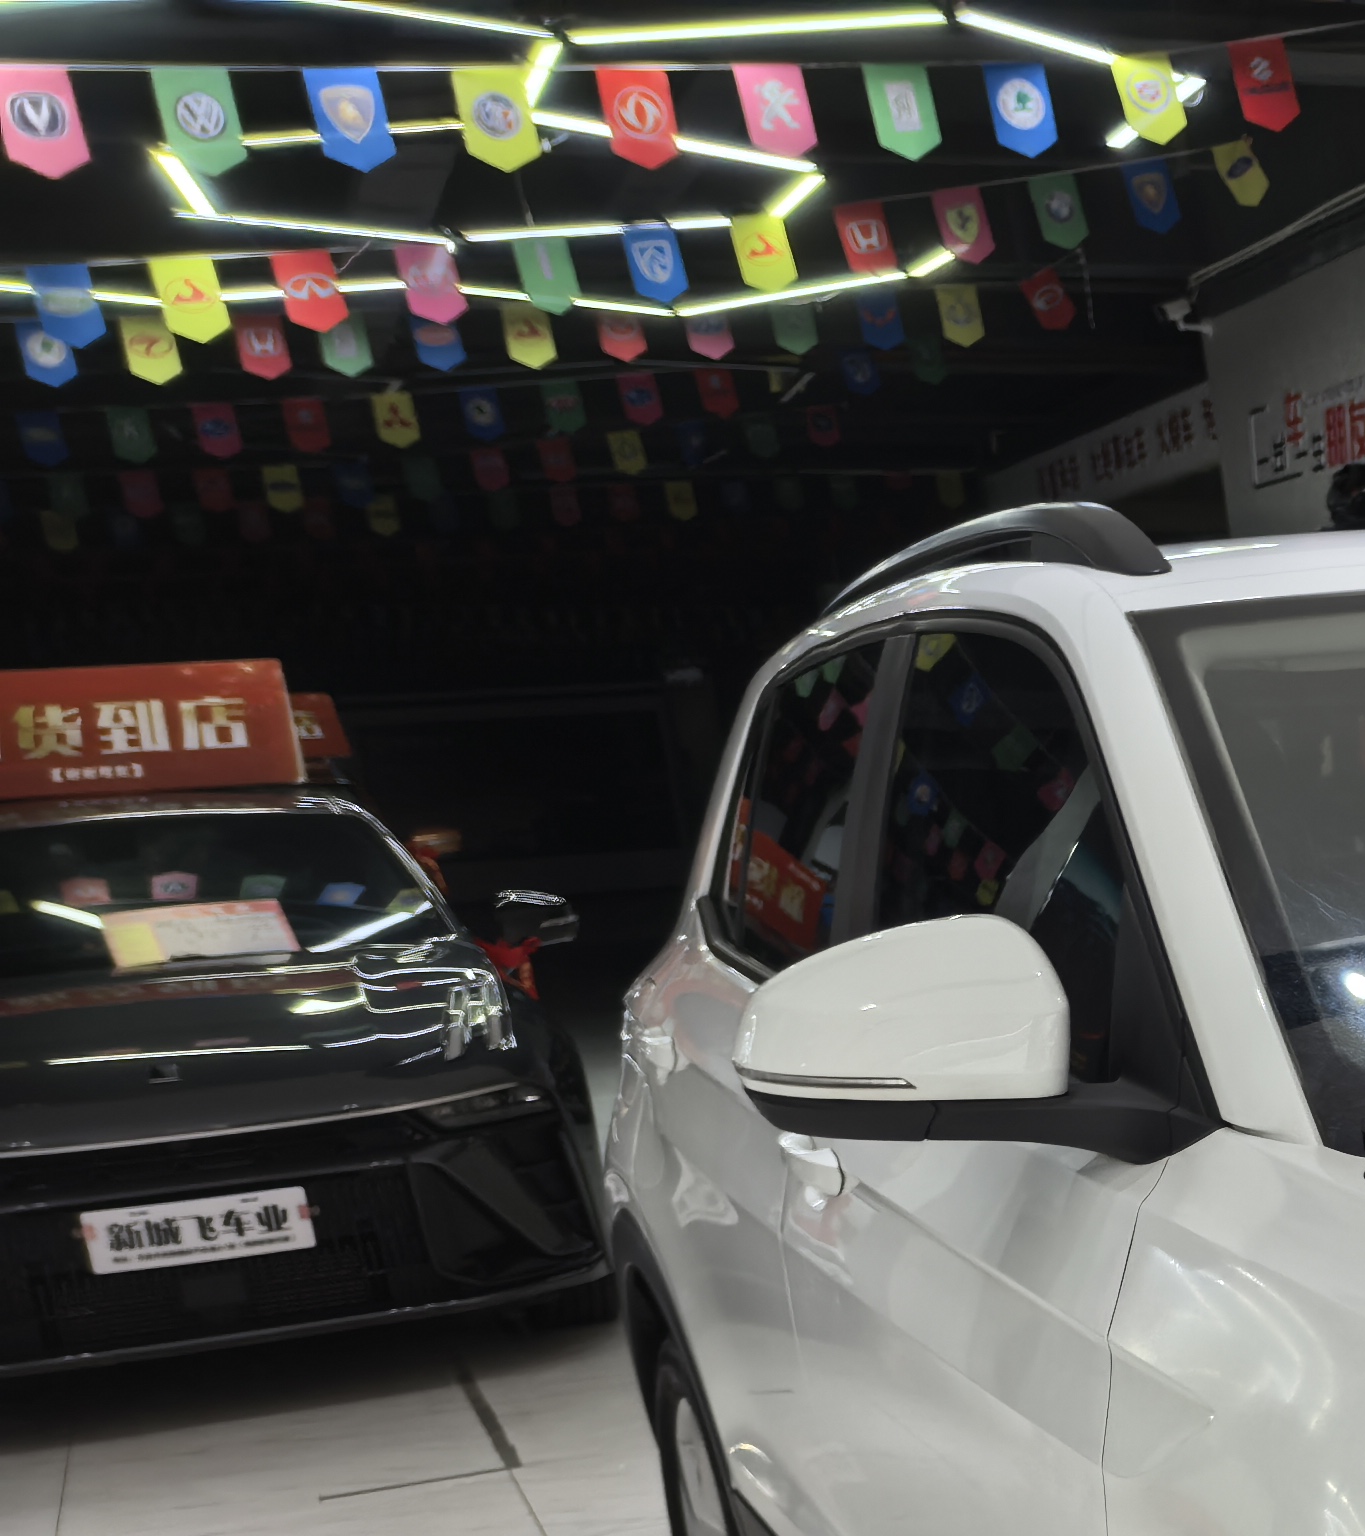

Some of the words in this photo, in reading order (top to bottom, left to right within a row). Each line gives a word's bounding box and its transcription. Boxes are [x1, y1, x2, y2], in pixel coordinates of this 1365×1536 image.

[107, 1204, 288, 1251] 新城飞车业
